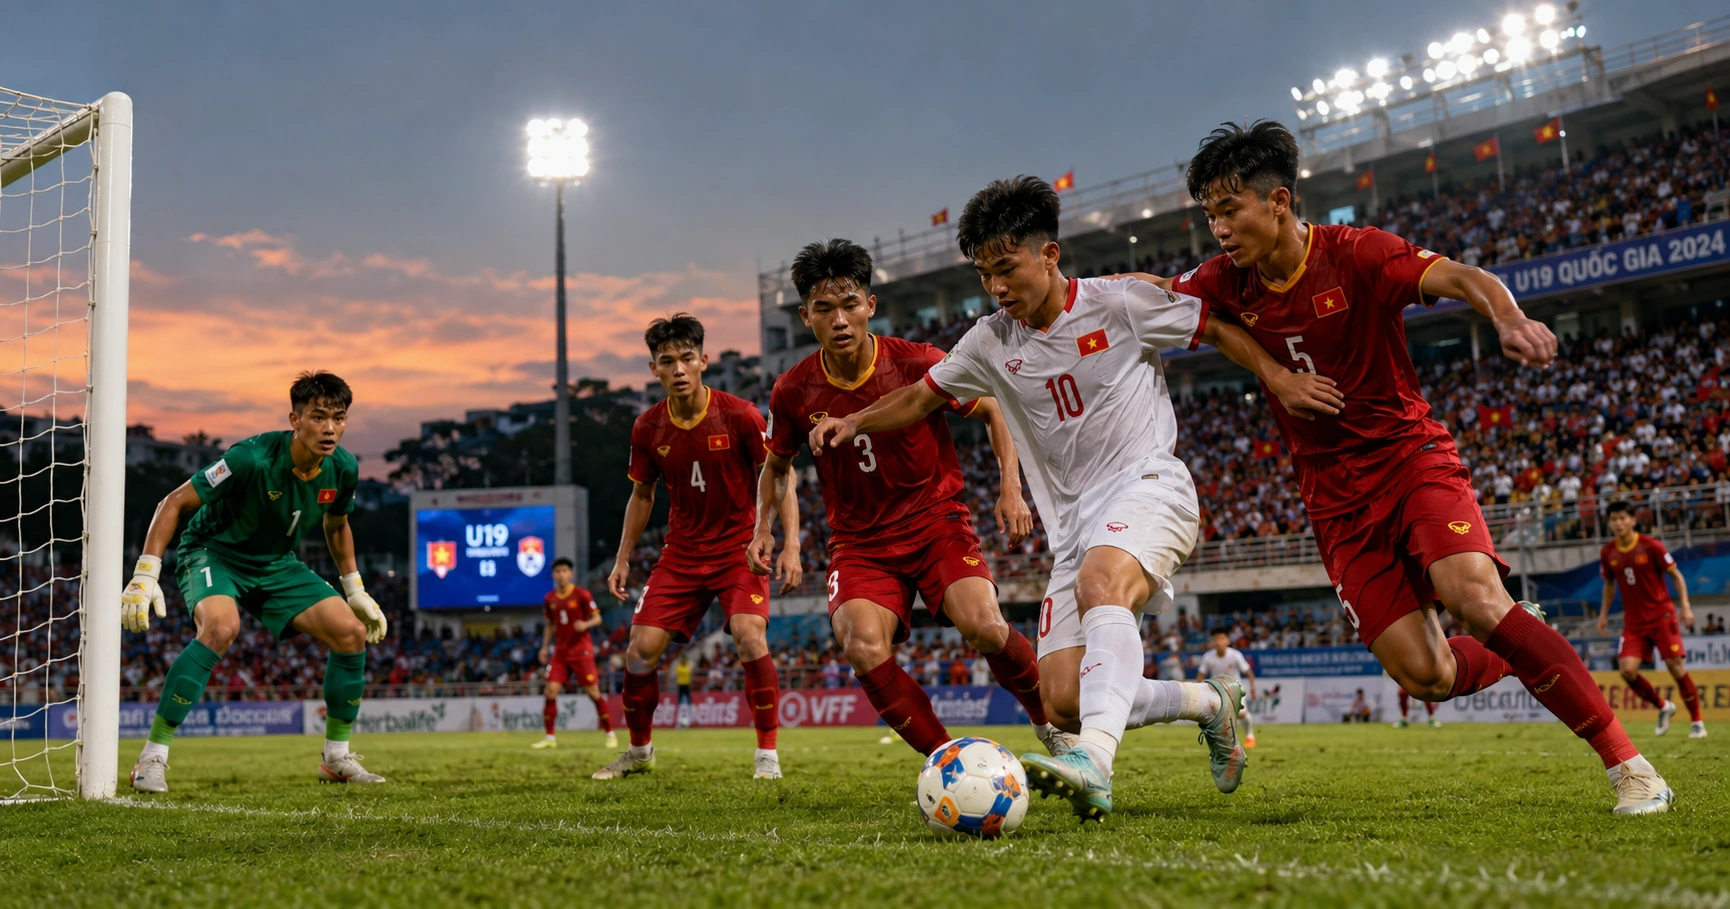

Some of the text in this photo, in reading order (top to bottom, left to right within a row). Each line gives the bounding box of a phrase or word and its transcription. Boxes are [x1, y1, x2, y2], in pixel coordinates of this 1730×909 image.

[1514, 265, 1554, 293] U19
[1558, 248, 1618, 286] QUỐC
[1623, 244, 1663, 273] GIA
[1667, 229, 1726, 264] 2024
[1285, 335, 1317, 375] 5
[1045, 373, 1084, 422] 10
[853, 433, 877, 473] 3
[691, 461, 706, 492] 4
[286, 510, 301, 537] 1
[465, 523, 509, 548] U19
[200, 566, 213, 588] 1
[827, 570, 839, 602] 3
[811, 695, 857, 724] VFF
